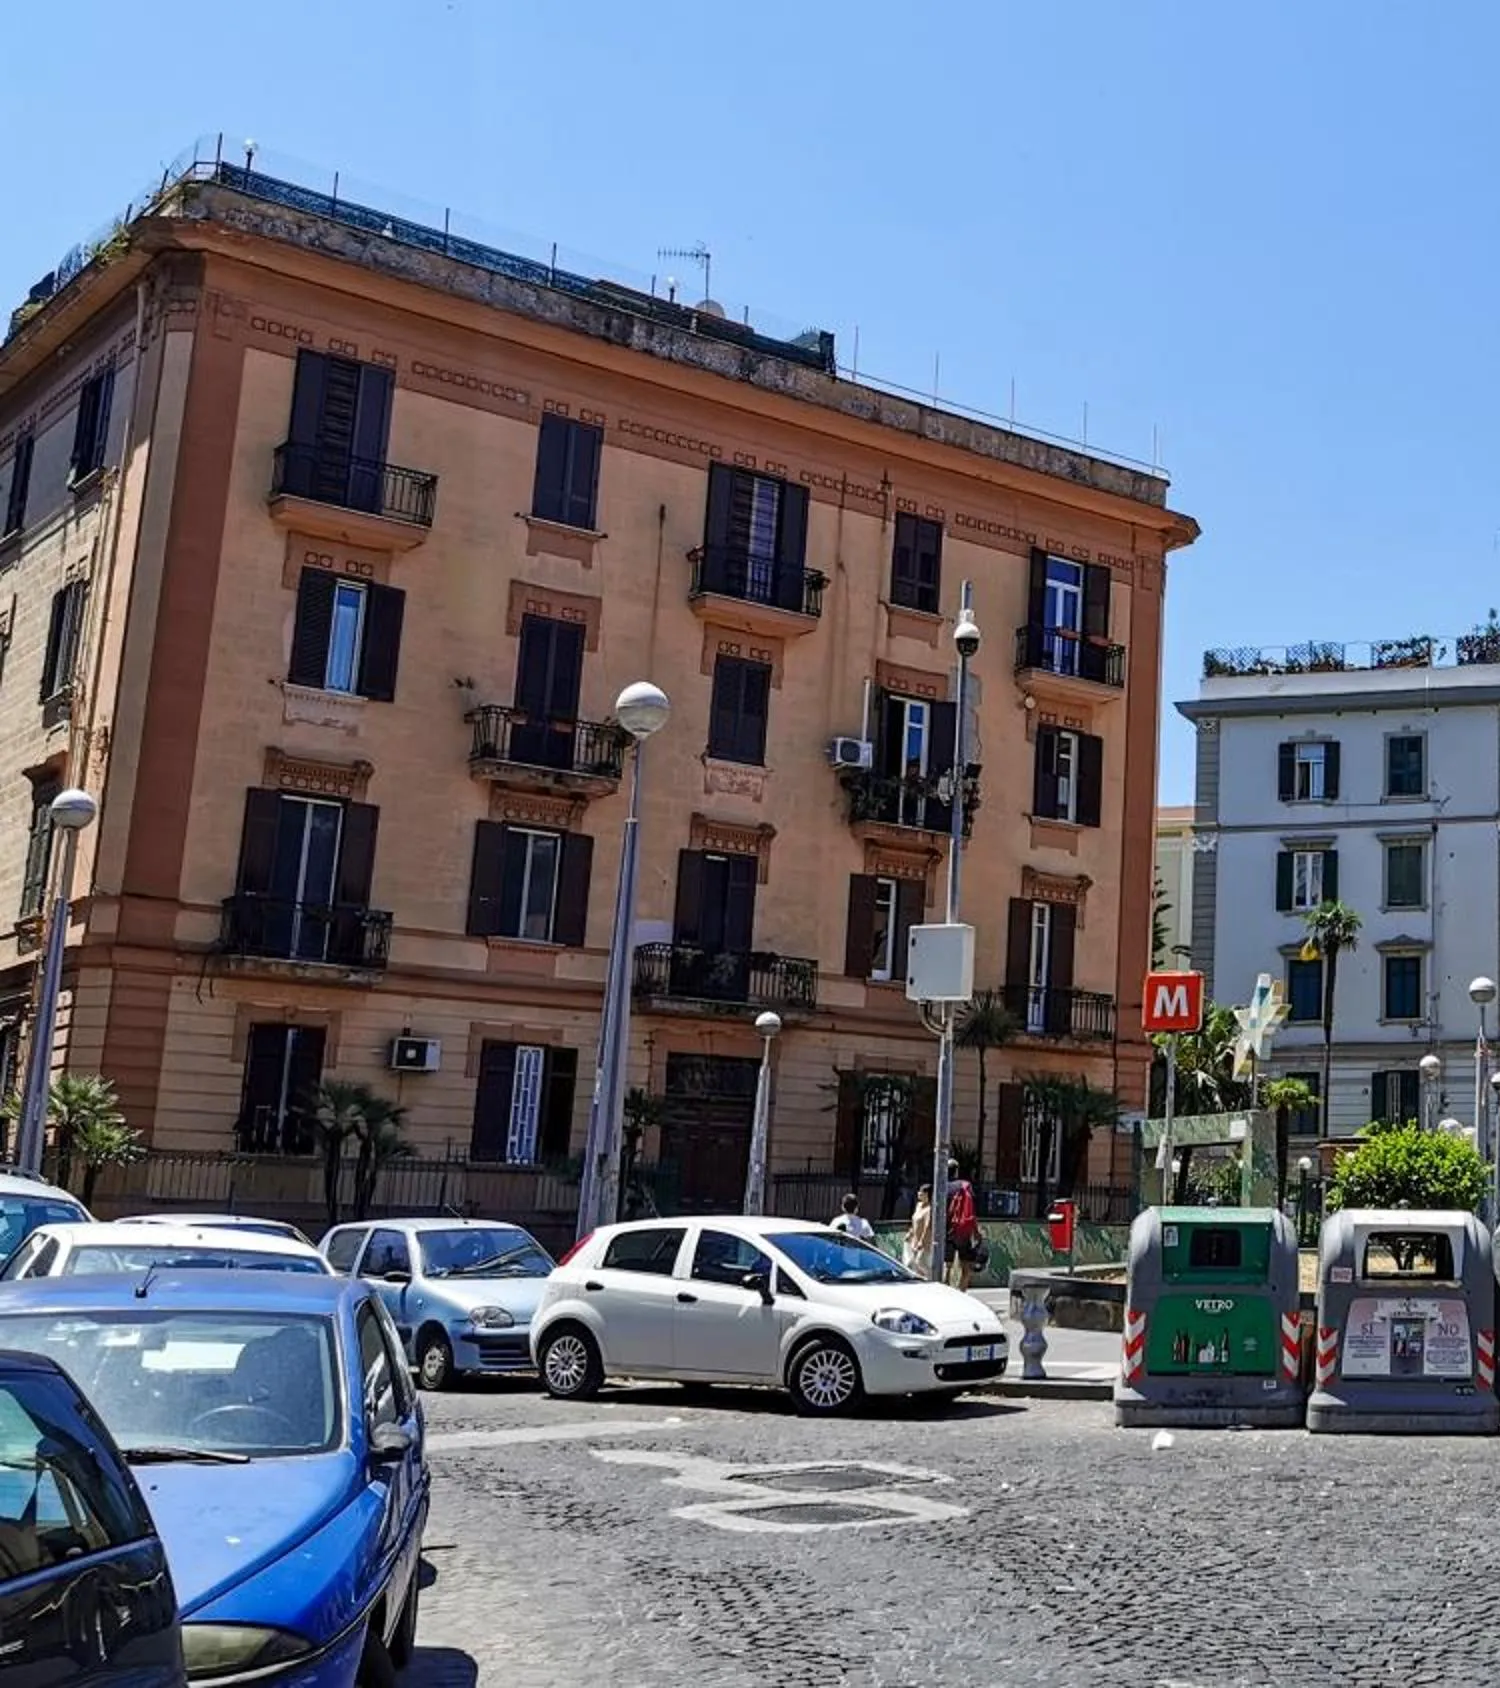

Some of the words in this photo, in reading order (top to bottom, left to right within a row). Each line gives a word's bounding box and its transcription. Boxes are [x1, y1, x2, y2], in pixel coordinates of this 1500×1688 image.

[1153, 985, 1189, 1018] M
[1195, 1299, 1234, 1310] VETRO
[1437, 1323, 1459, 1337] NO
